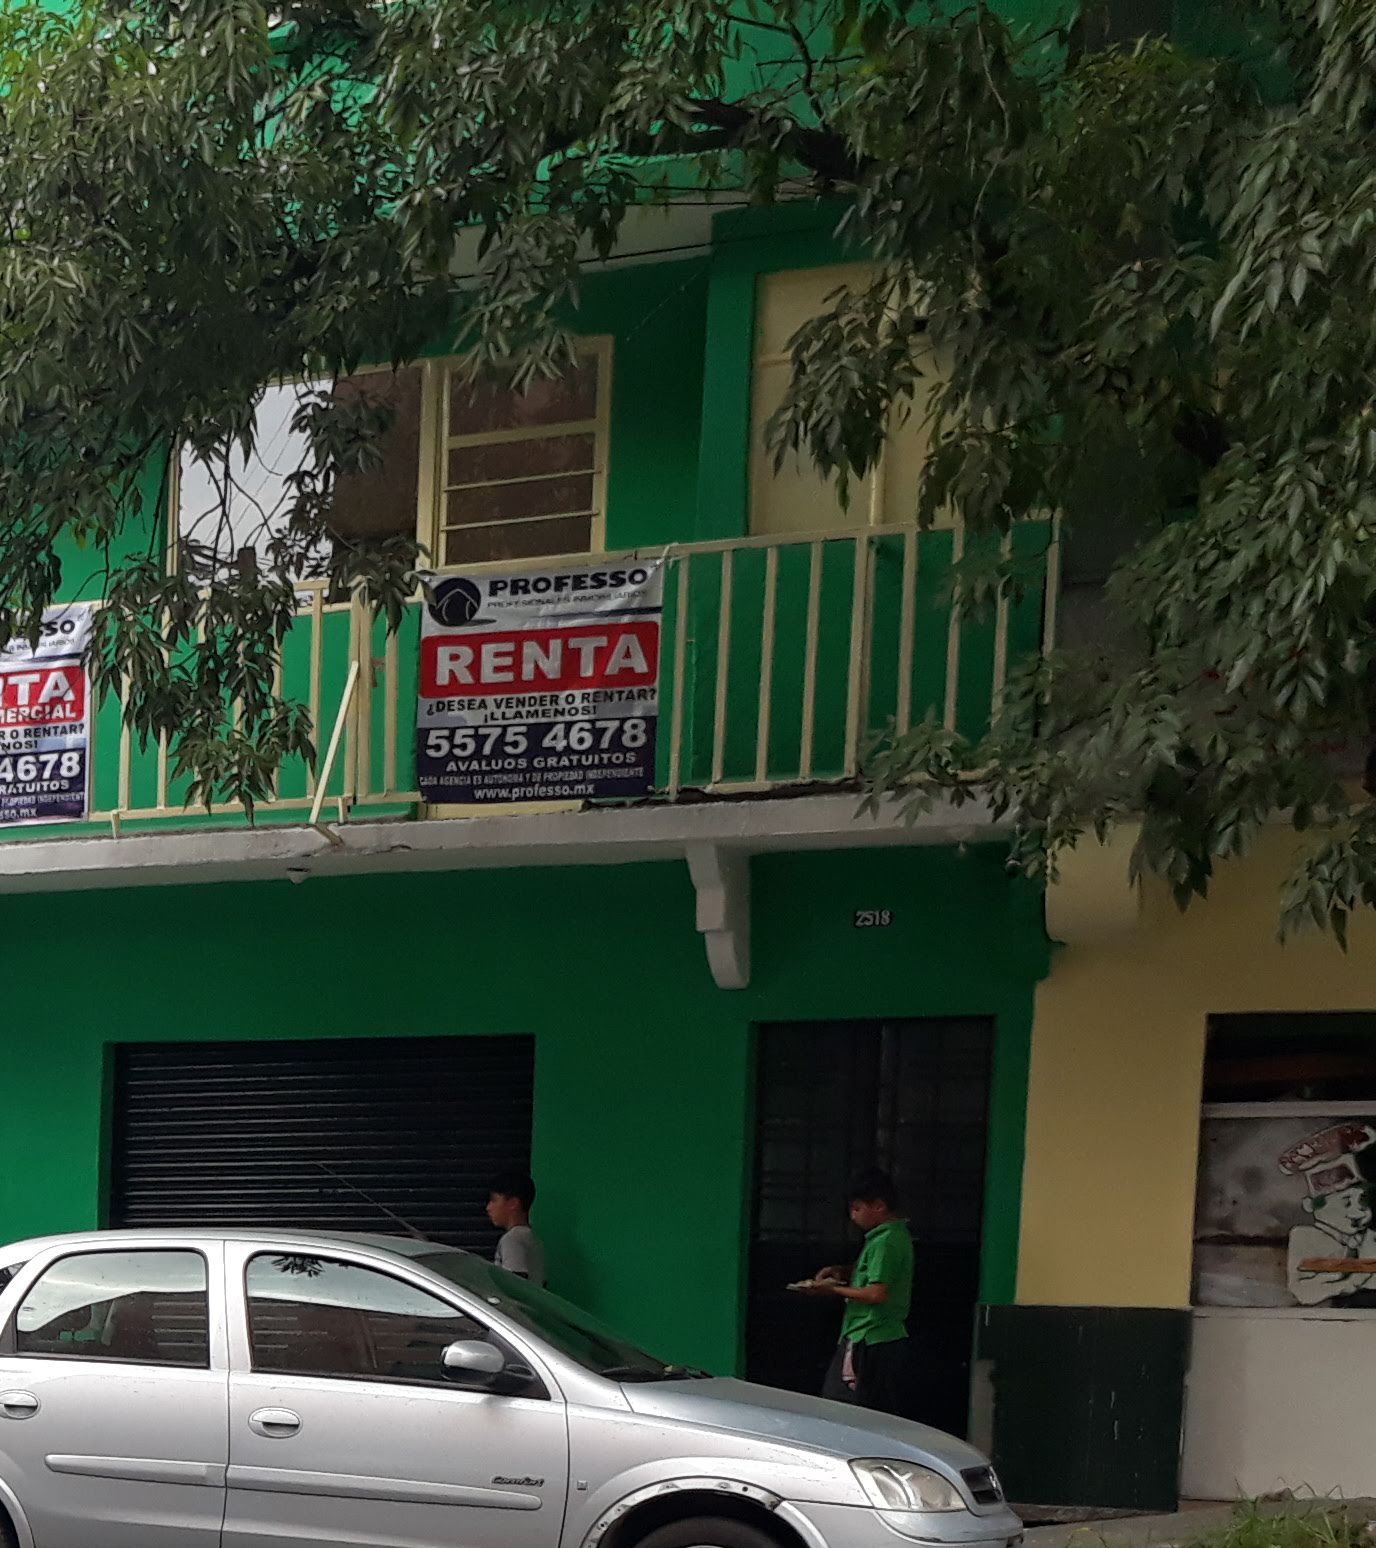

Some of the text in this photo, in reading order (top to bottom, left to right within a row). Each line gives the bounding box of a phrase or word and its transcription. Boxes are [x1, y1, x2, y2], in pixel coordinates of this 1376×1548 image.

[488, 568, 648, 598] PROFESSO
[435, 633, 649, 686] RENTA
[426, 688, 656, 716] ¿DESEA VENDER O RENTAR?
[484, 705, 597, 723] ¡LLAMENOS!
[10, 729, 19, 740] O
[23, 724, 85, 740] RENTAR?
[425, 718, 647, 759] 5575 4678
[446, 751, 637, 772] AVALUOS GRATUITOS
[474, 784, 595, 801] www.professo.mx
